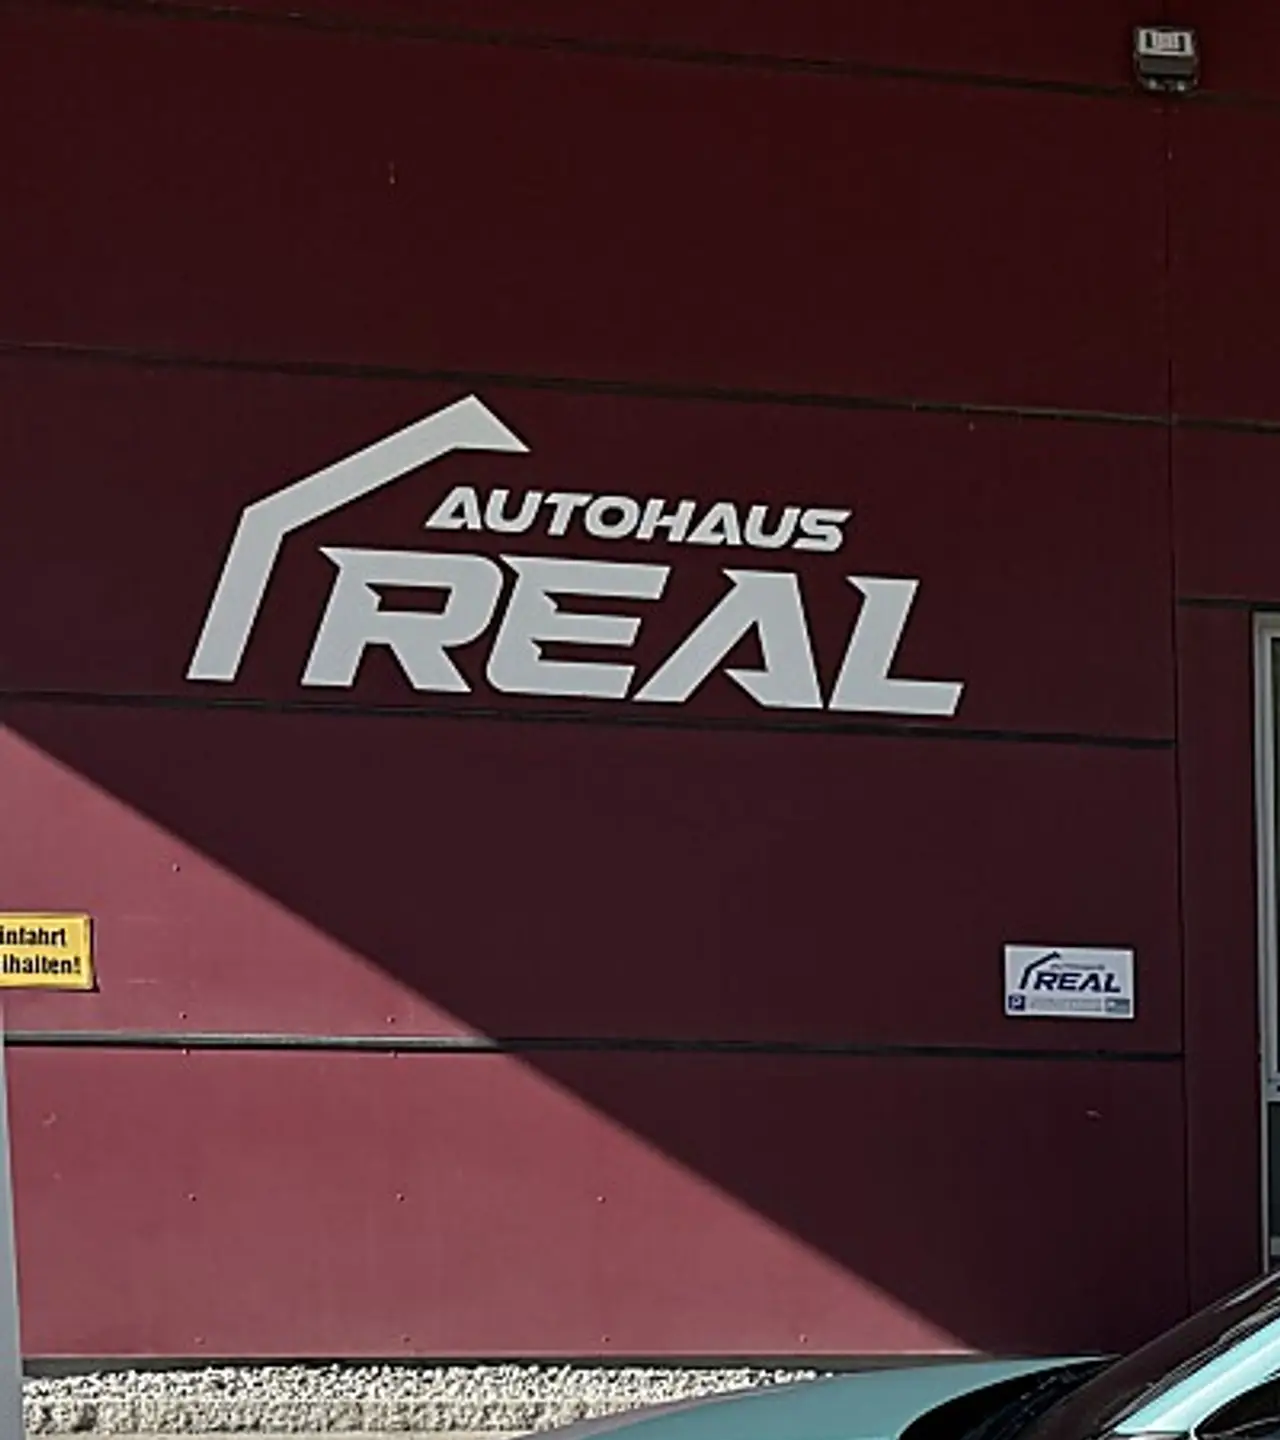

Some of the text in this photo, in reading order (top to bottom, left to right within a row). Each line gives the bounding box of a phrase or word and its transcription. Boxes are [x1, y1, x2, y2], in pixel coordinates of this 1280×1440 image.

[424, 486, 852, 553] AUTOHAUS
[301, 546, 964, 716] REAL
[1033, 970, 1122, 993] REAL
